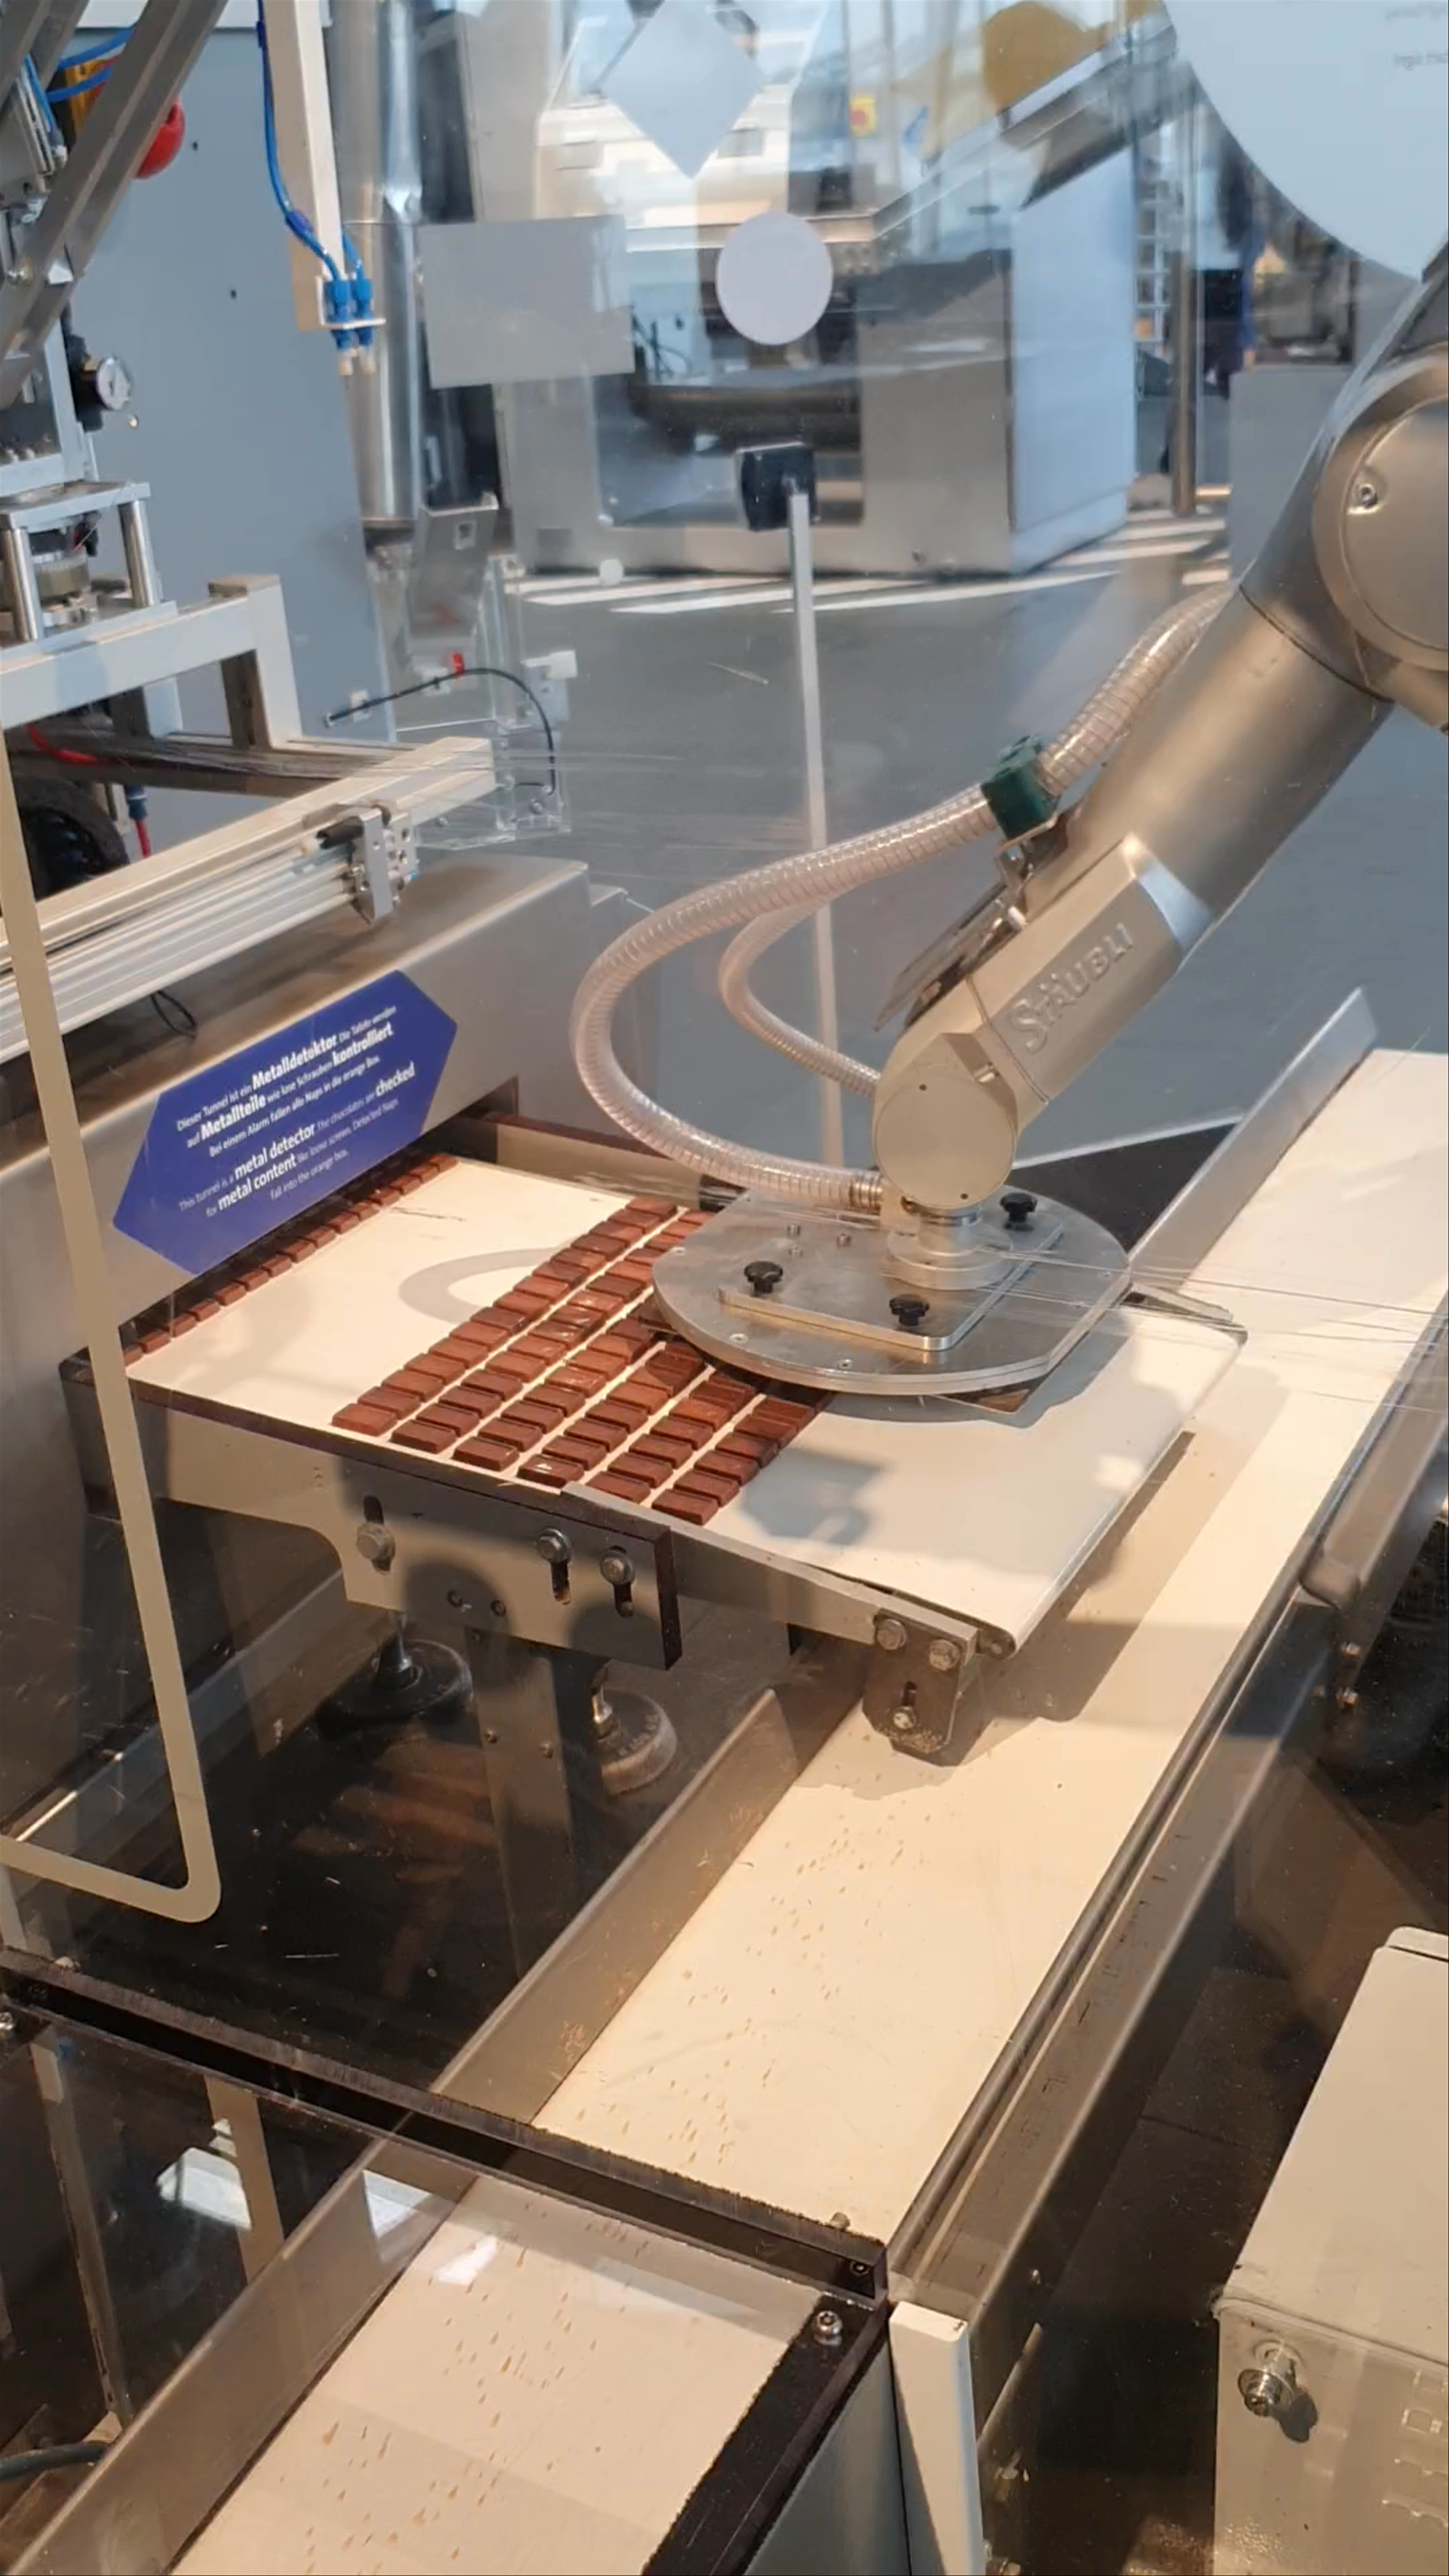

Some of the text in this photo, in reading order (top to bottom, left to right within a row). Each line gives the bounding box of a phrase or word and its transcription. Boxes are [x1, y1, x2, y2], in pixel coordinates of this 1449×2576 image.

[1007, 922, 1134, 1054] STÄUBLI
[177, 1112, 201, 1131] Dieser
[203, 1095, 228, 1116] Tunnel
[229, 1090, 239, 1103] ist
[240, 1085, 252, 1096] ein
[252, 1034, 337, 1090] Metalldetektor
[178, 1199, 195, 1211] This
[221, 1178, 228, 1188] is
[229, 1175, 233, 1184] a
[235, 1147, 268, 1181] metal
[269, 1123, 315, 1159] detector
[317, 1118, 330, 1130] The
[331, 1099, 365, 1124] chocolates
[375, 1060, 415, 1097] checked
[187, 1021, 393, 1148] auf Metallteile wie lose Schrauben kontrolliert
[209, 1142, 223, 1158] Bei
[223, 1130, 247, 1149] einem
[248, 1117, 269, 1136] Alarm
[270, 1106, 291, 1122] fallen
[292, 1097, 305, 1110] alle
[305, 1086, 323, 1103] Naps
[323, 1083, 331, 1092] in
[332, 1076, 342, 1088] die
[343, 1064, 365, 1082] orange
[206, 1207, 217, 1217] for
[218, 1177, 252, 1210] metal
[254, 1152, 297, 1189] content
[297, 1151, 309, 1163] like
[310, 1140, 328, 1156] loose
[353, 1105, 382, 1130] Detected
[283, 1180, 298, 1192] into
[298, 1171, 310, 1184] the
[310, 1157, 334, 1177] orange
